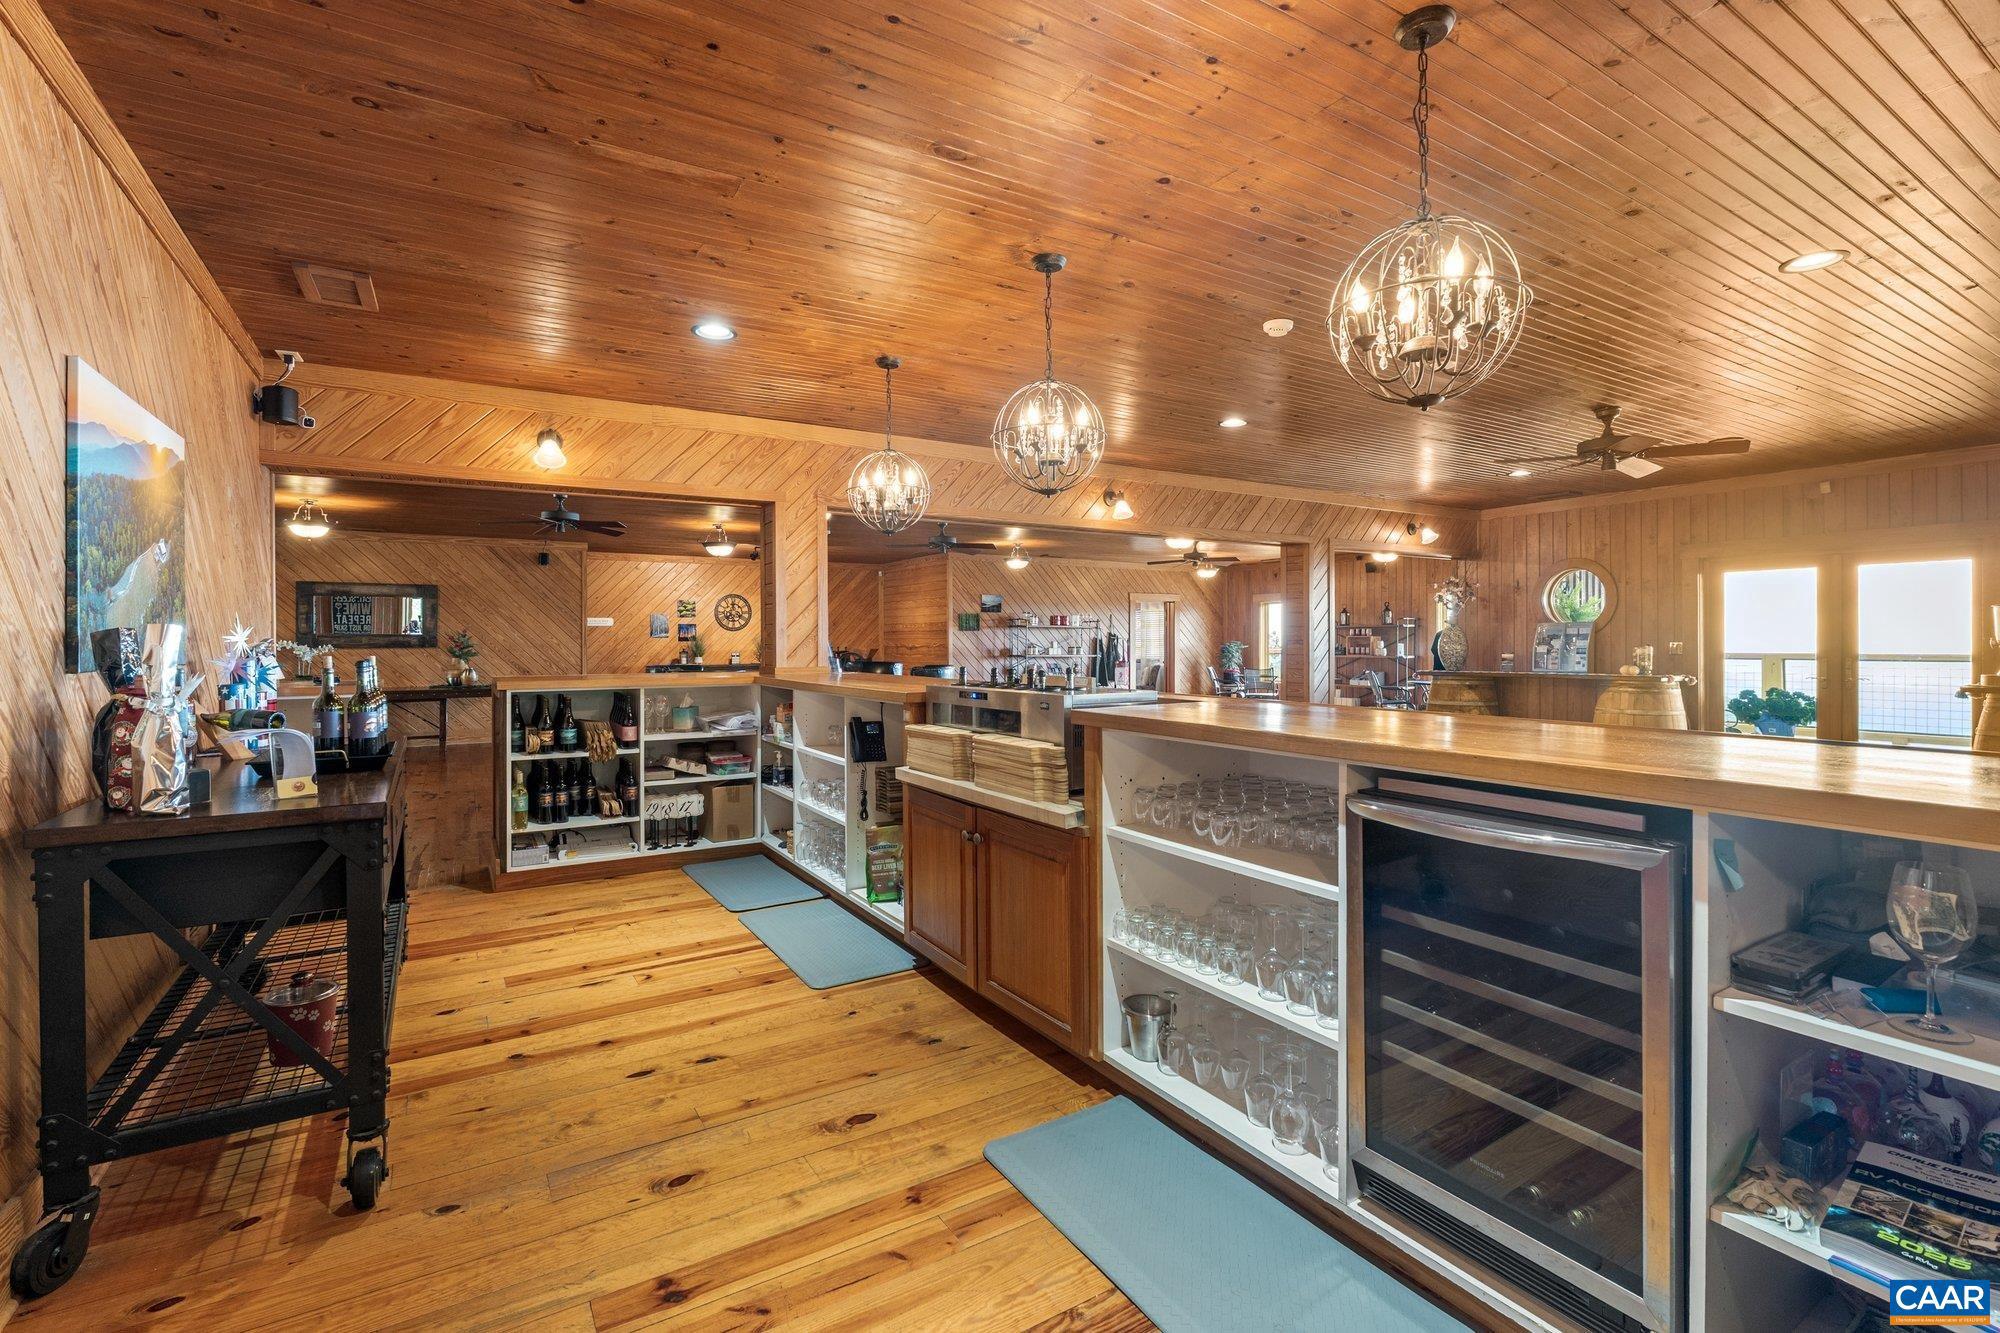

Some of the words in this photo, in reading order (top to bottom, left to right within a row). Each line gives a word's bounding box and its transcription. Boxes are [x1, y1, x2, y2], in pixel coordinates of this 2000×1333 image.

[646, 803, 659, 815] 19
[679, 801, 694, 812] 17
[1887, 1150, 1941, 1169] CHARLIE
[1854, 1168, 1884, 1179] RV
[1877, 1230, 1972, 1271] 2025
[1901, 1251, 1914, 1259] Go
